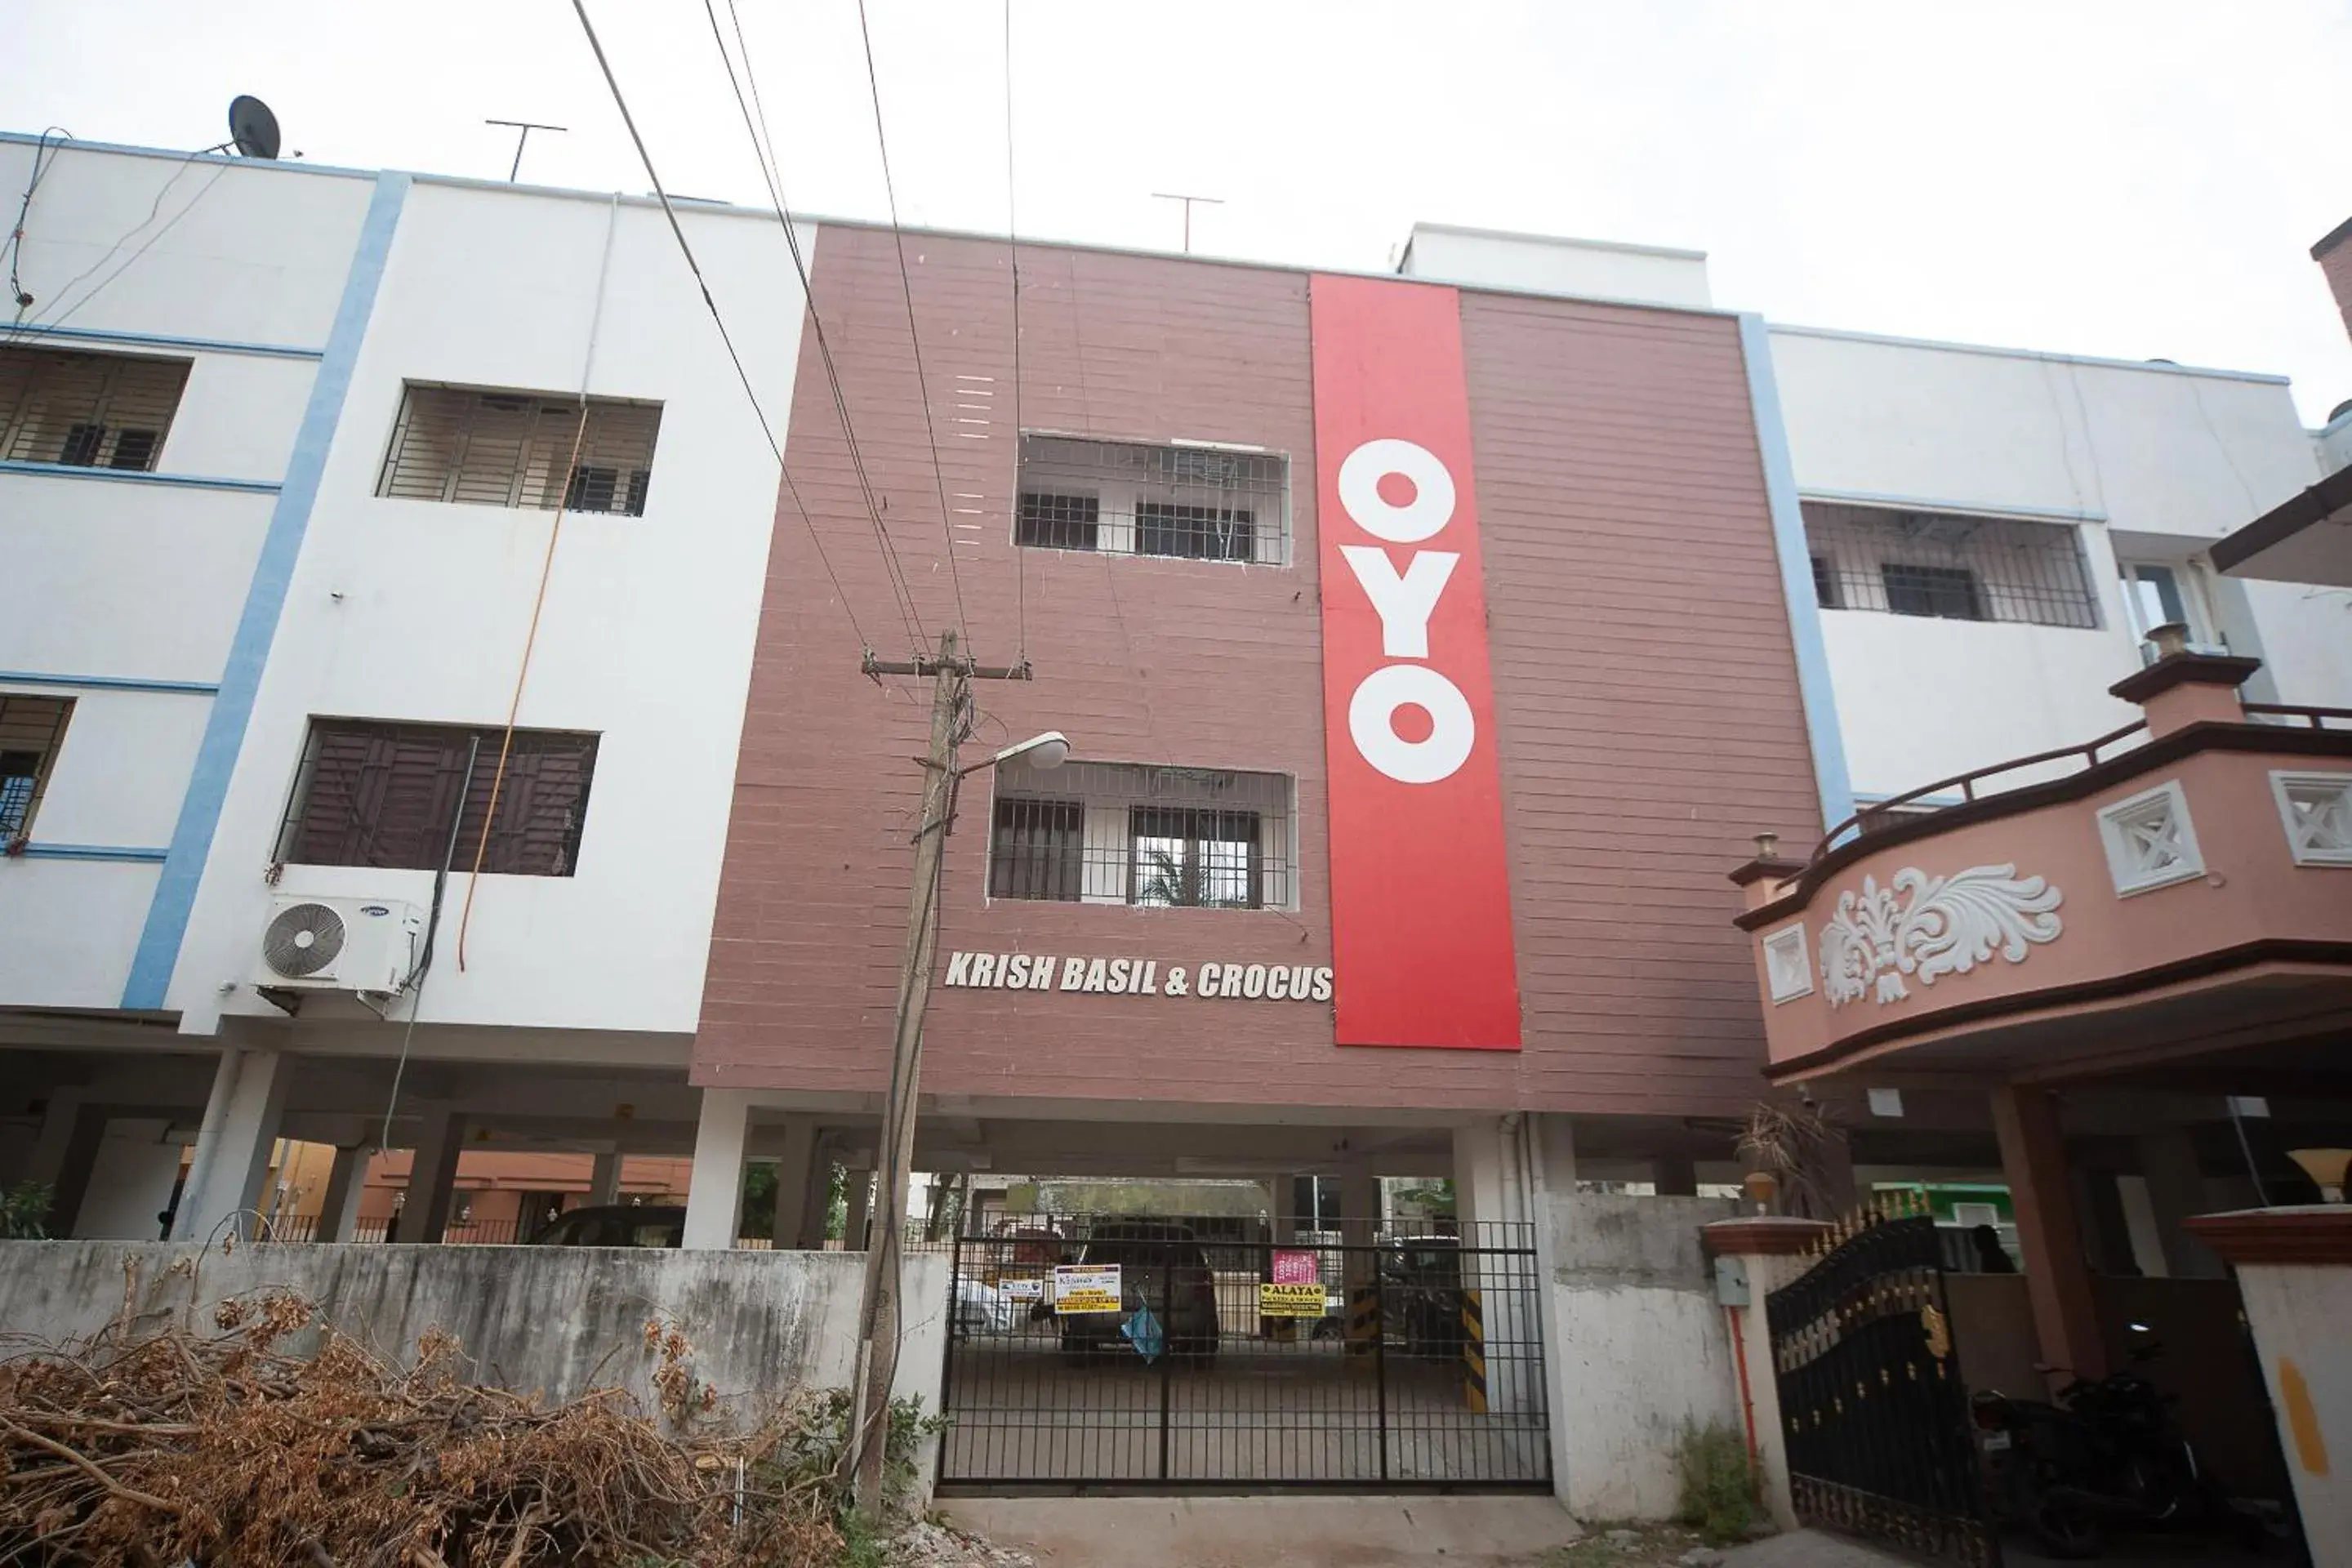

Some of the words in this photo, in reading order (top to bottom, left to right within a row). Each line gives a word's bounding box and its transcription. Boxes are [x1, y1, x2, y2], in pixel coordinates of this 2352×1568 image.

[1338, 438, 1475, 784] OYO
[945, 951, 1056, 990] KRISH
[1059, 957, 1157, 994] BASIL
[1164, 966, 1190, 996] &
[1196, 962, 1334, 1001] CROCUS
[1272, 1285, 1313, 1295] ALAYA
